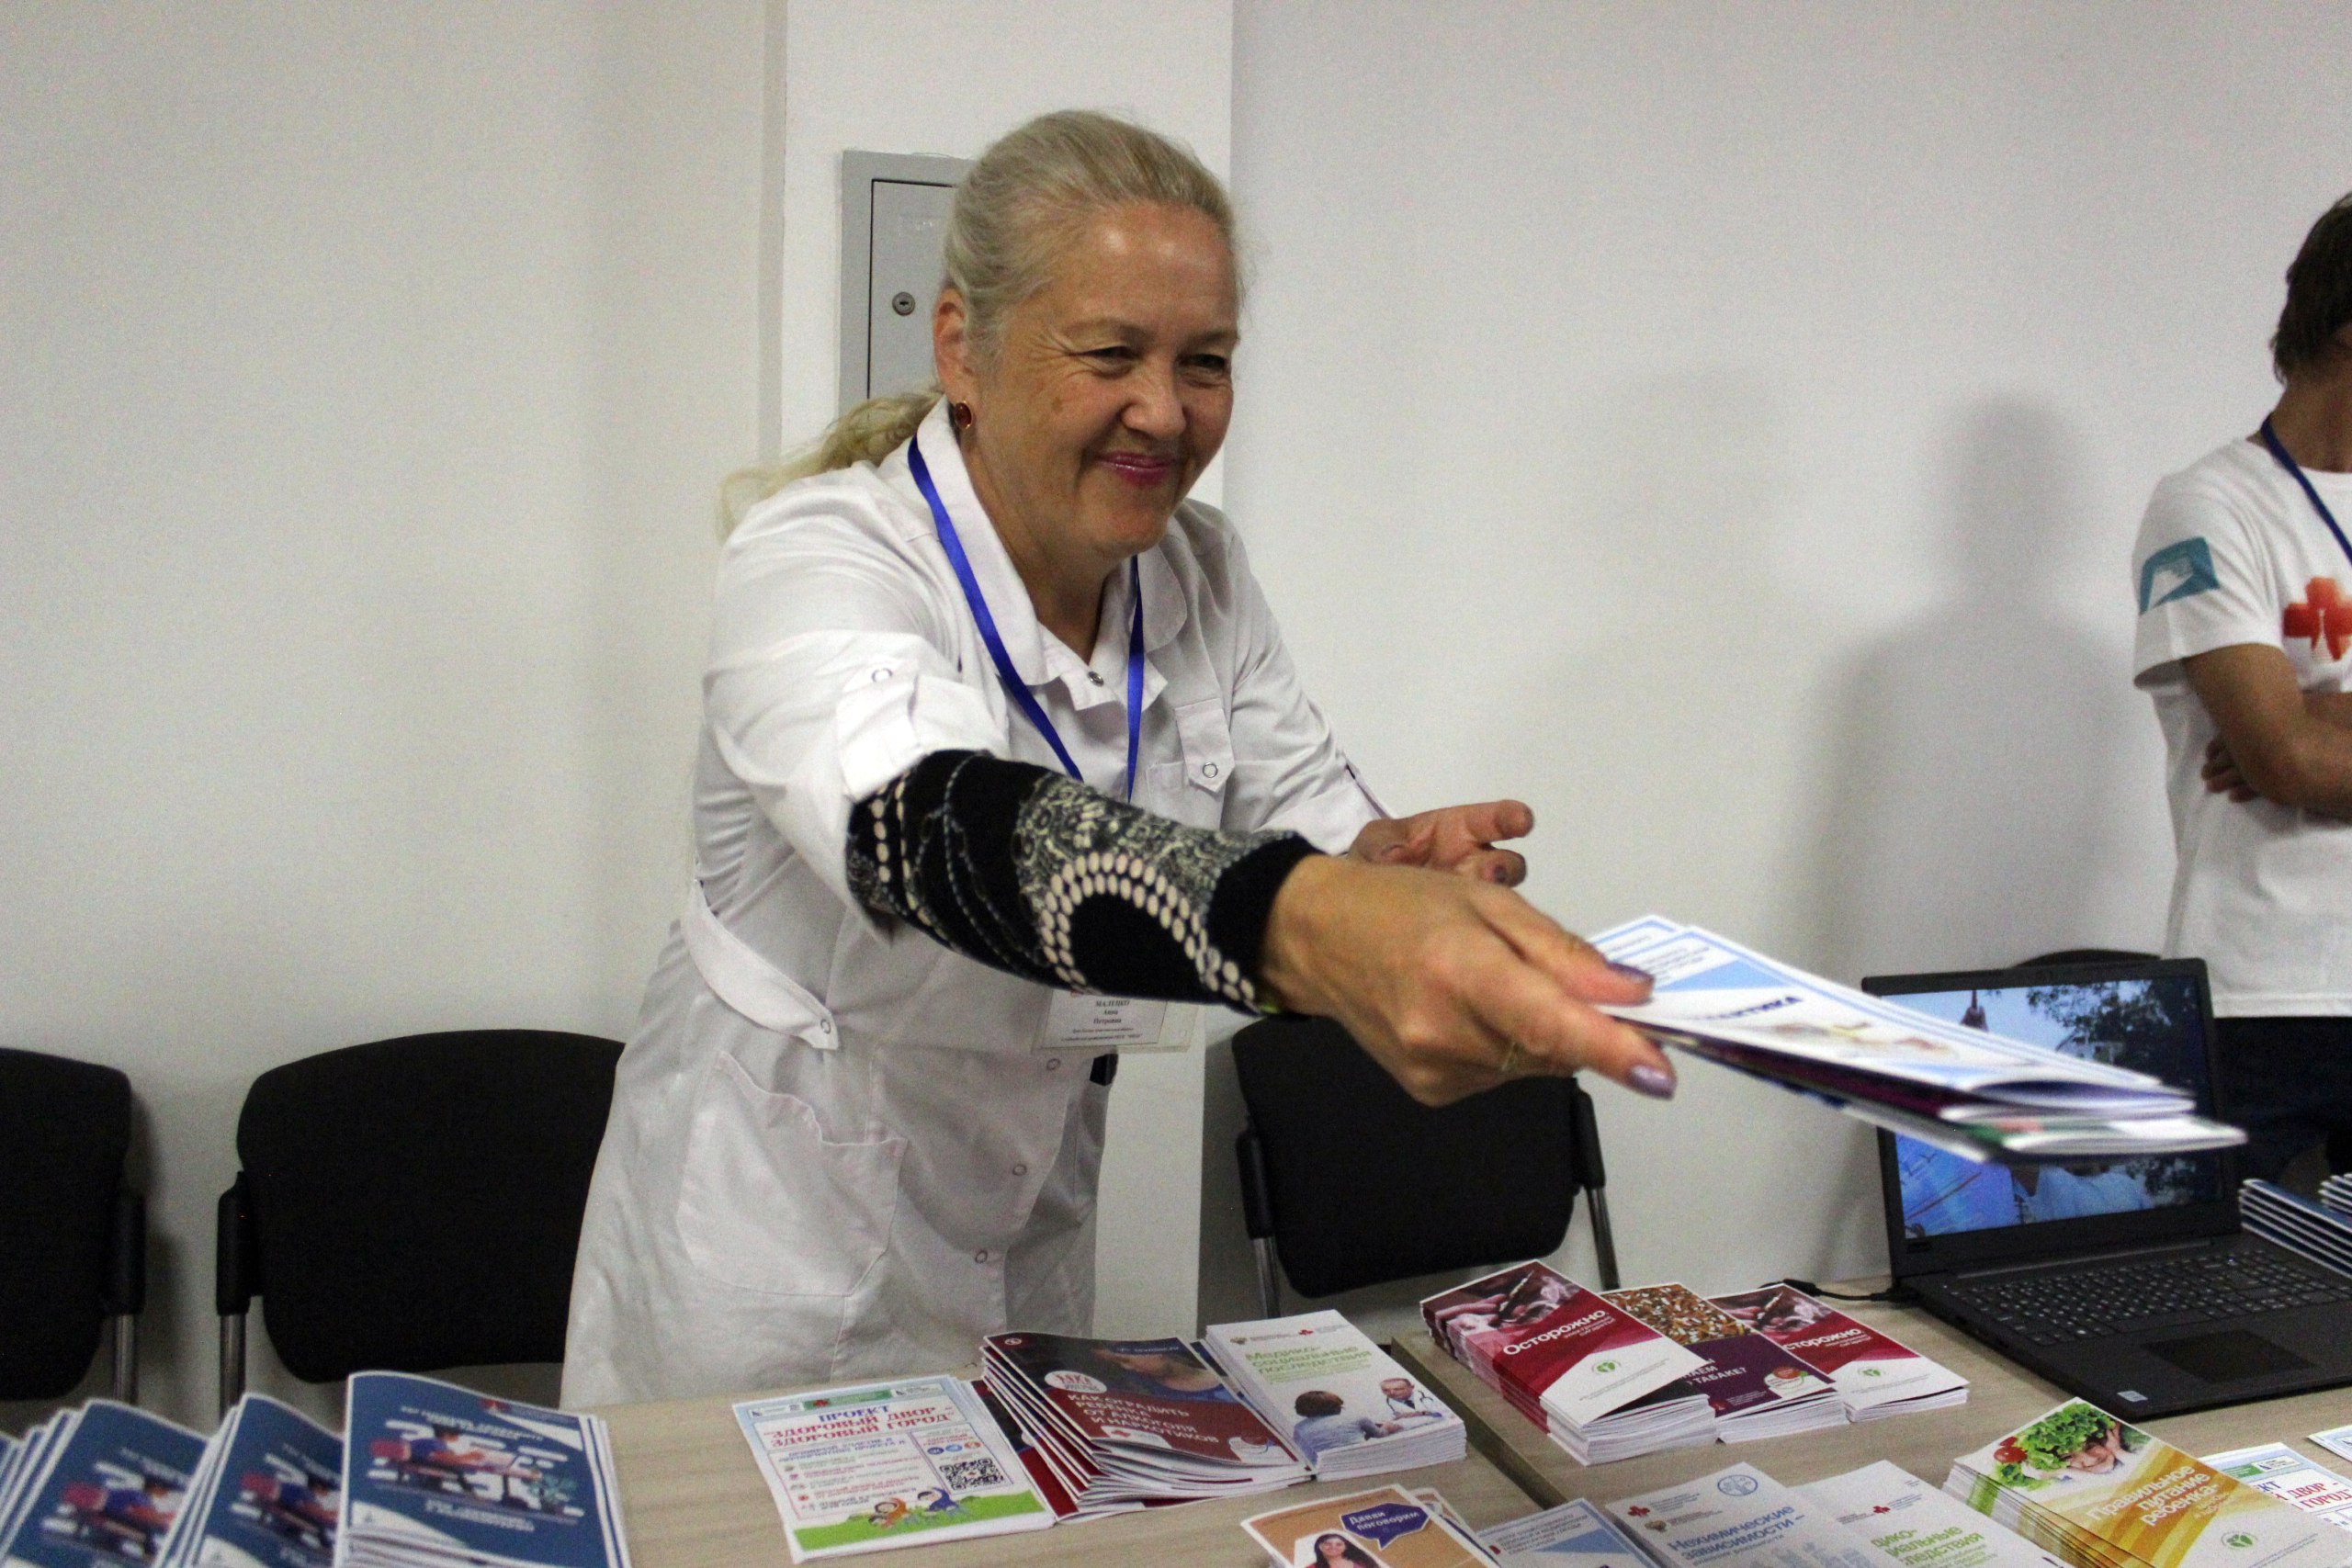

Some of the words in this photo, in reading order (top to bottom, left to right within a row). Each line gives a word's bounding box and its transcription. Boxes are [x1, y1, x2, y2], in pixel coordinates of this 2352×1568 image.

[1692, 1367, 1747, 1383] ТАБАКЕ?
[819, 1405, 889, 1422] ПРОЕКТ
[887, 1406, 935, 1421] ДВОР
[1068, 1393, 1101, 1404] КАК
[1105, 1396, 1190, 1417] ОГРАДИТЬ
[1075, 1402, 1151, 1417] РЕБЕНКА
[1083, 1409, 1105, 1417] ОТ
[1111, 1412, 1198, 1433] АЛКОГОЛЯ
[1108, 1418, 1219, 1443] НАРКОТИКОВ
[770, 1425, 879, 1448] ЗДОРОВЫЙ
[2087, 1466, 2195, 1520] Правильное
[2137, 1473, 2211, 1511] питание
[2287, 1483, 2327, 1499] ДВОР
[1349, 1512, 1385, 1525] Давай
[1356, 1512, 1419, 1531] поговорим
[1668, 1505, 1795, 1551] Нехимические
[1682, 1518, 1794, 1560] зависимости
